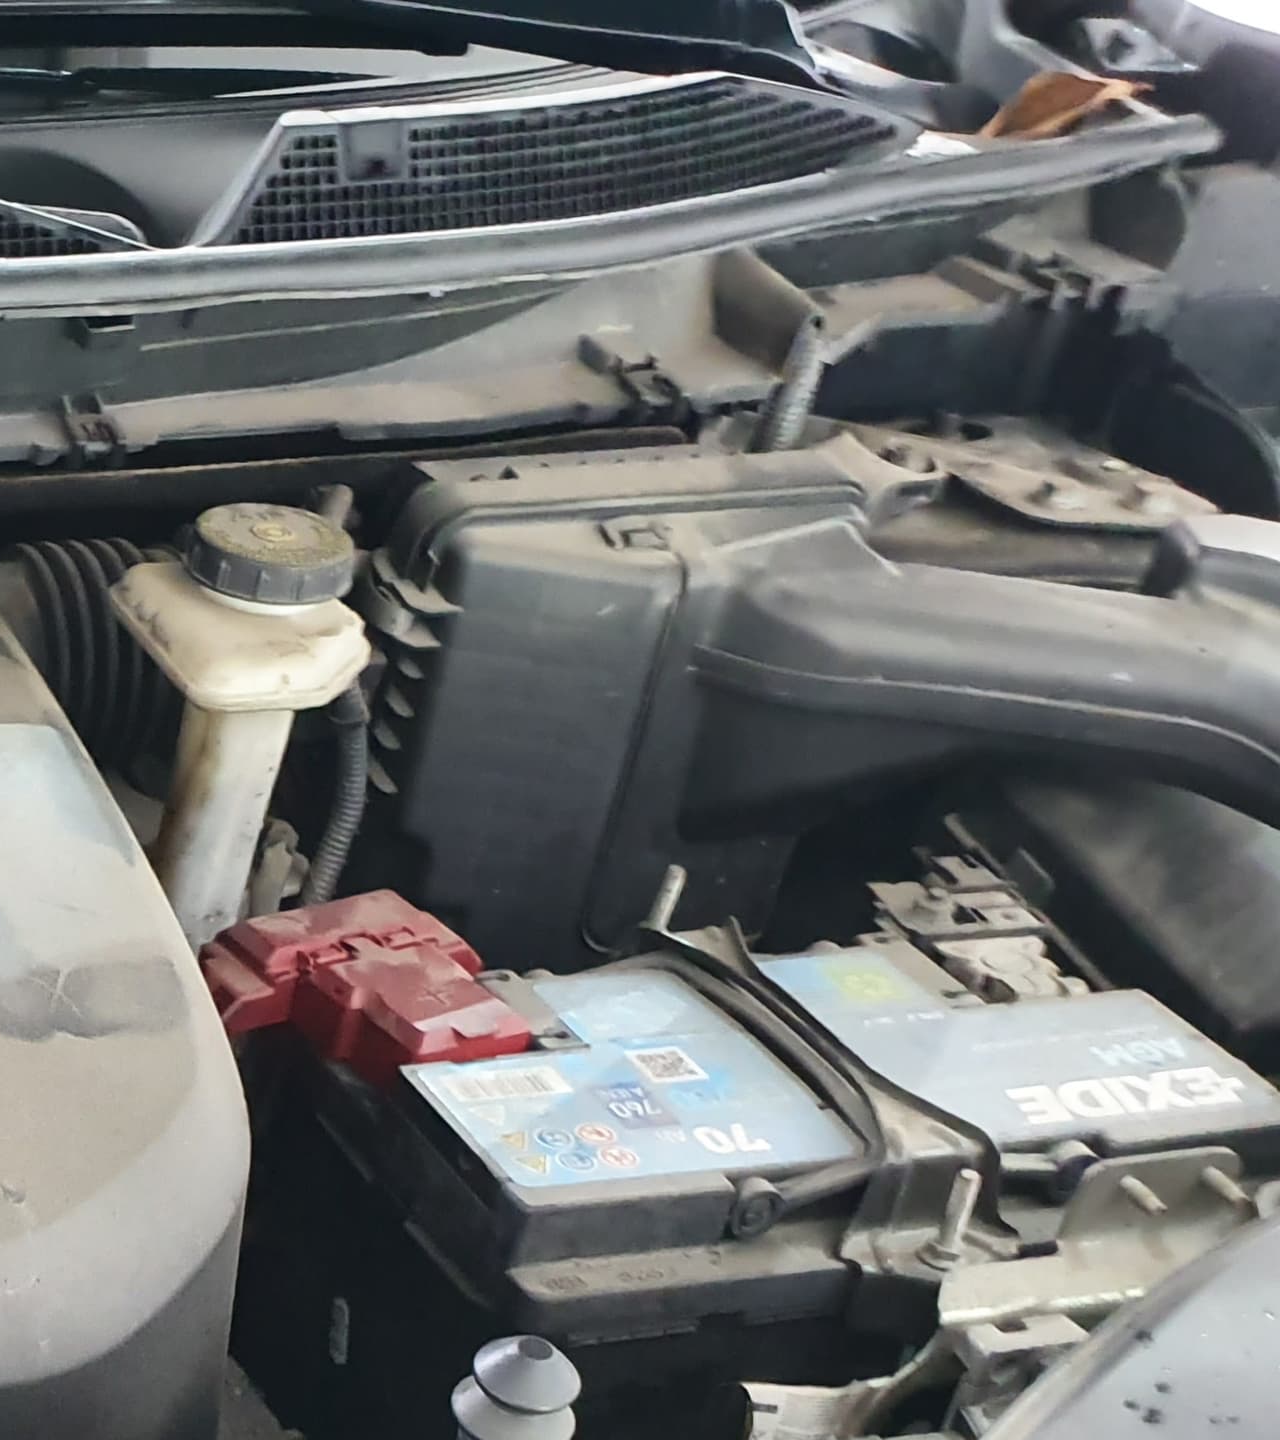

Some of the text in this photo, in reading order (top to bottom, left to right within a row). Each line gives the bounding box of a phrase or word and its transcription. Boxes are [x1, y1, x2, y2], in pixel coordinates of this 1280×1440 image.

[607, 1098, 662, 1119] 760
[1004, 1066, 1245, 1125] EXIDE
[692, 1122, 773, 1154] 70
